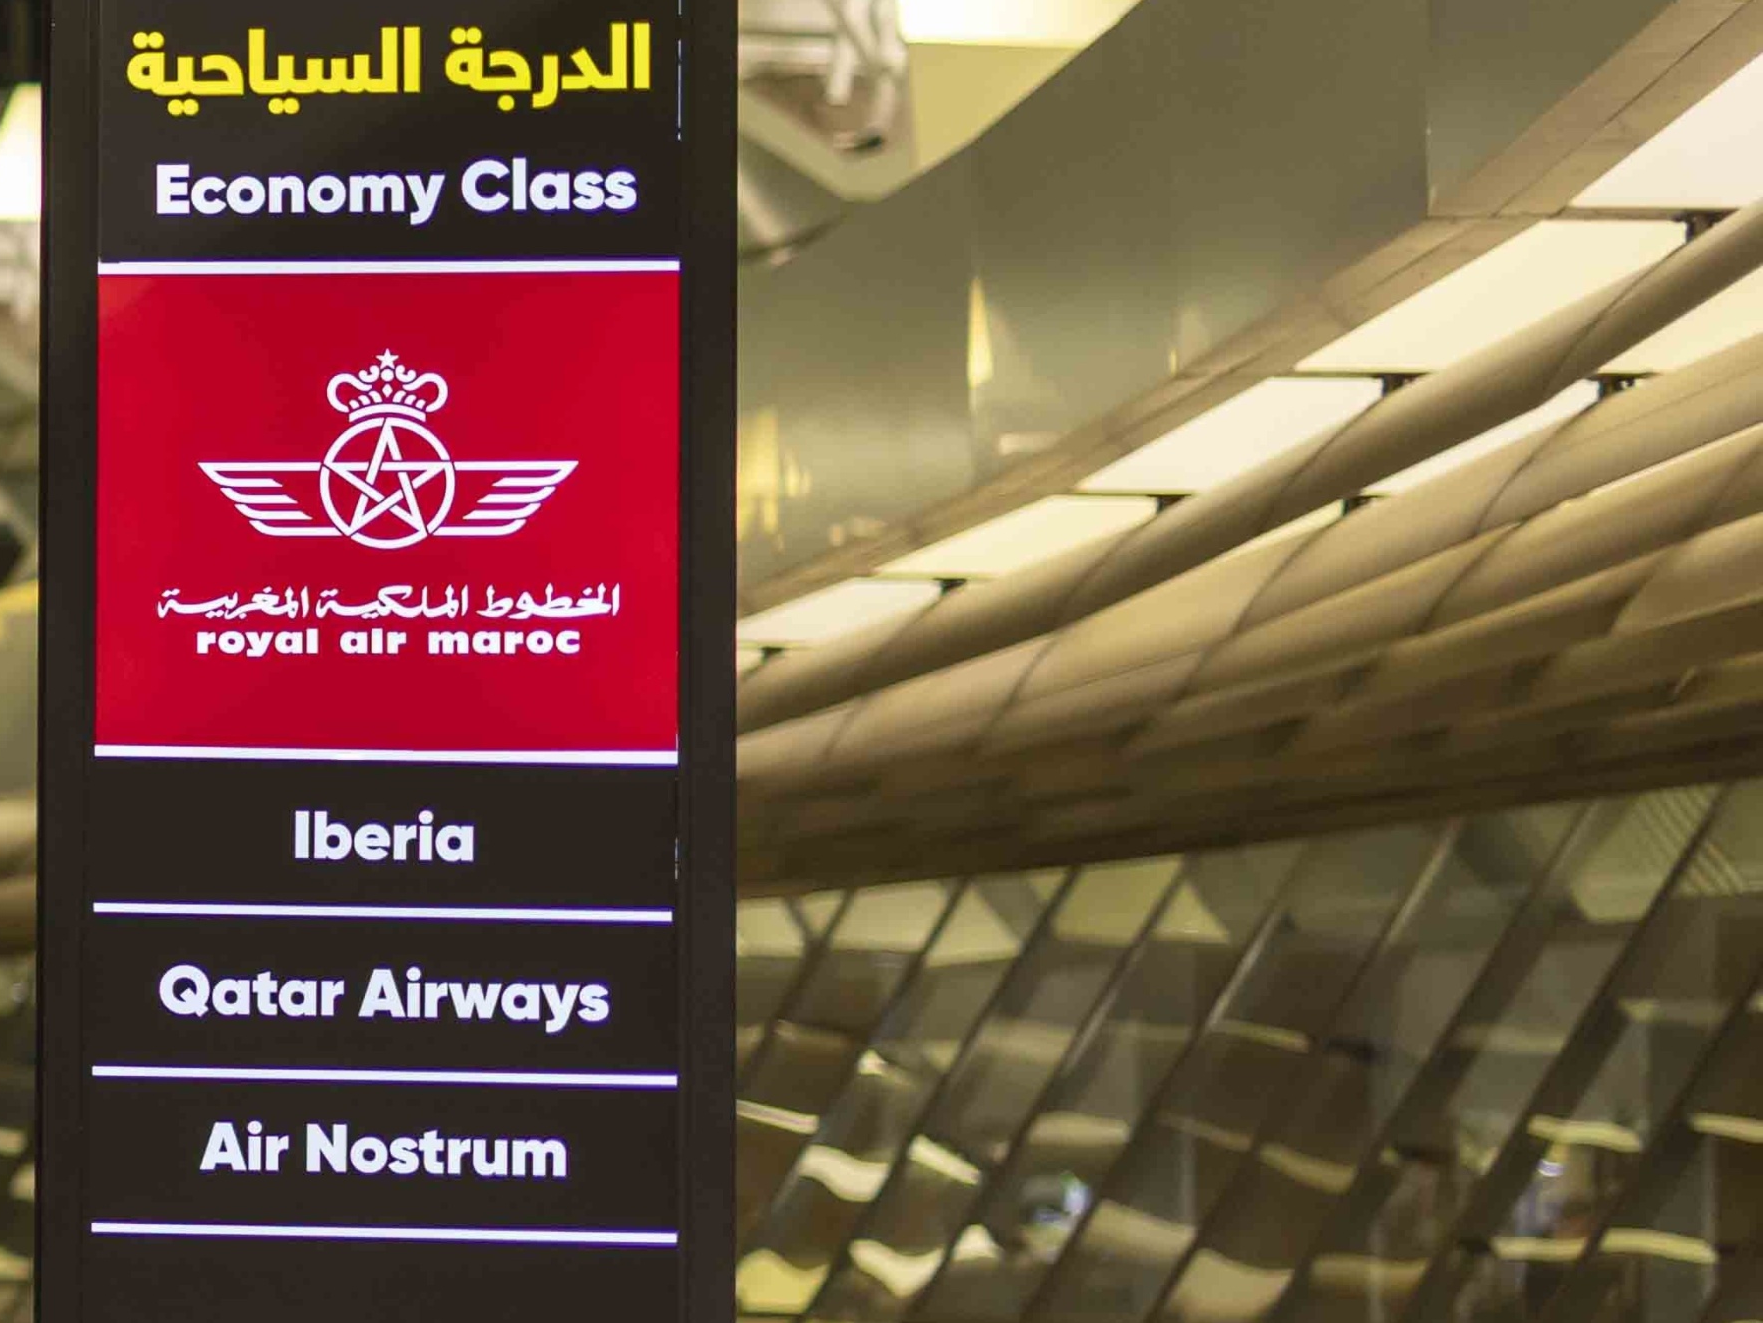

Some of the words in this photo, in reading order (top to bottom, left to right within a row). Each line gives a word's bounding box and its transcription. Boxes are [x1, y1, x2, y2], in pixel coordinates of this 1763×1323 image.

[125, 26, 422, 116] السياحية
[443, 22, 652, 112] الدرجة
[155, 163, 446, 226] Economy
[460, 156, 638, 213] Class
[157, 585, 310, 620] المغربية
[314, 584, 469, 620] الملكية
[476, 583, 621, 620] الخطوط
[196, 627, 320, 658] royal
[339, 627, 408, 655] air
[427, 629, 581, 656] maroc
[293, 809, 475, 863] Iberia
[158, 964, 345, 1018] Qatar
[357, 966, 611, 1034] Airways
[198, 1120, 291, 1173] Air
[305, 1122, 568, 1178] Nostrum
